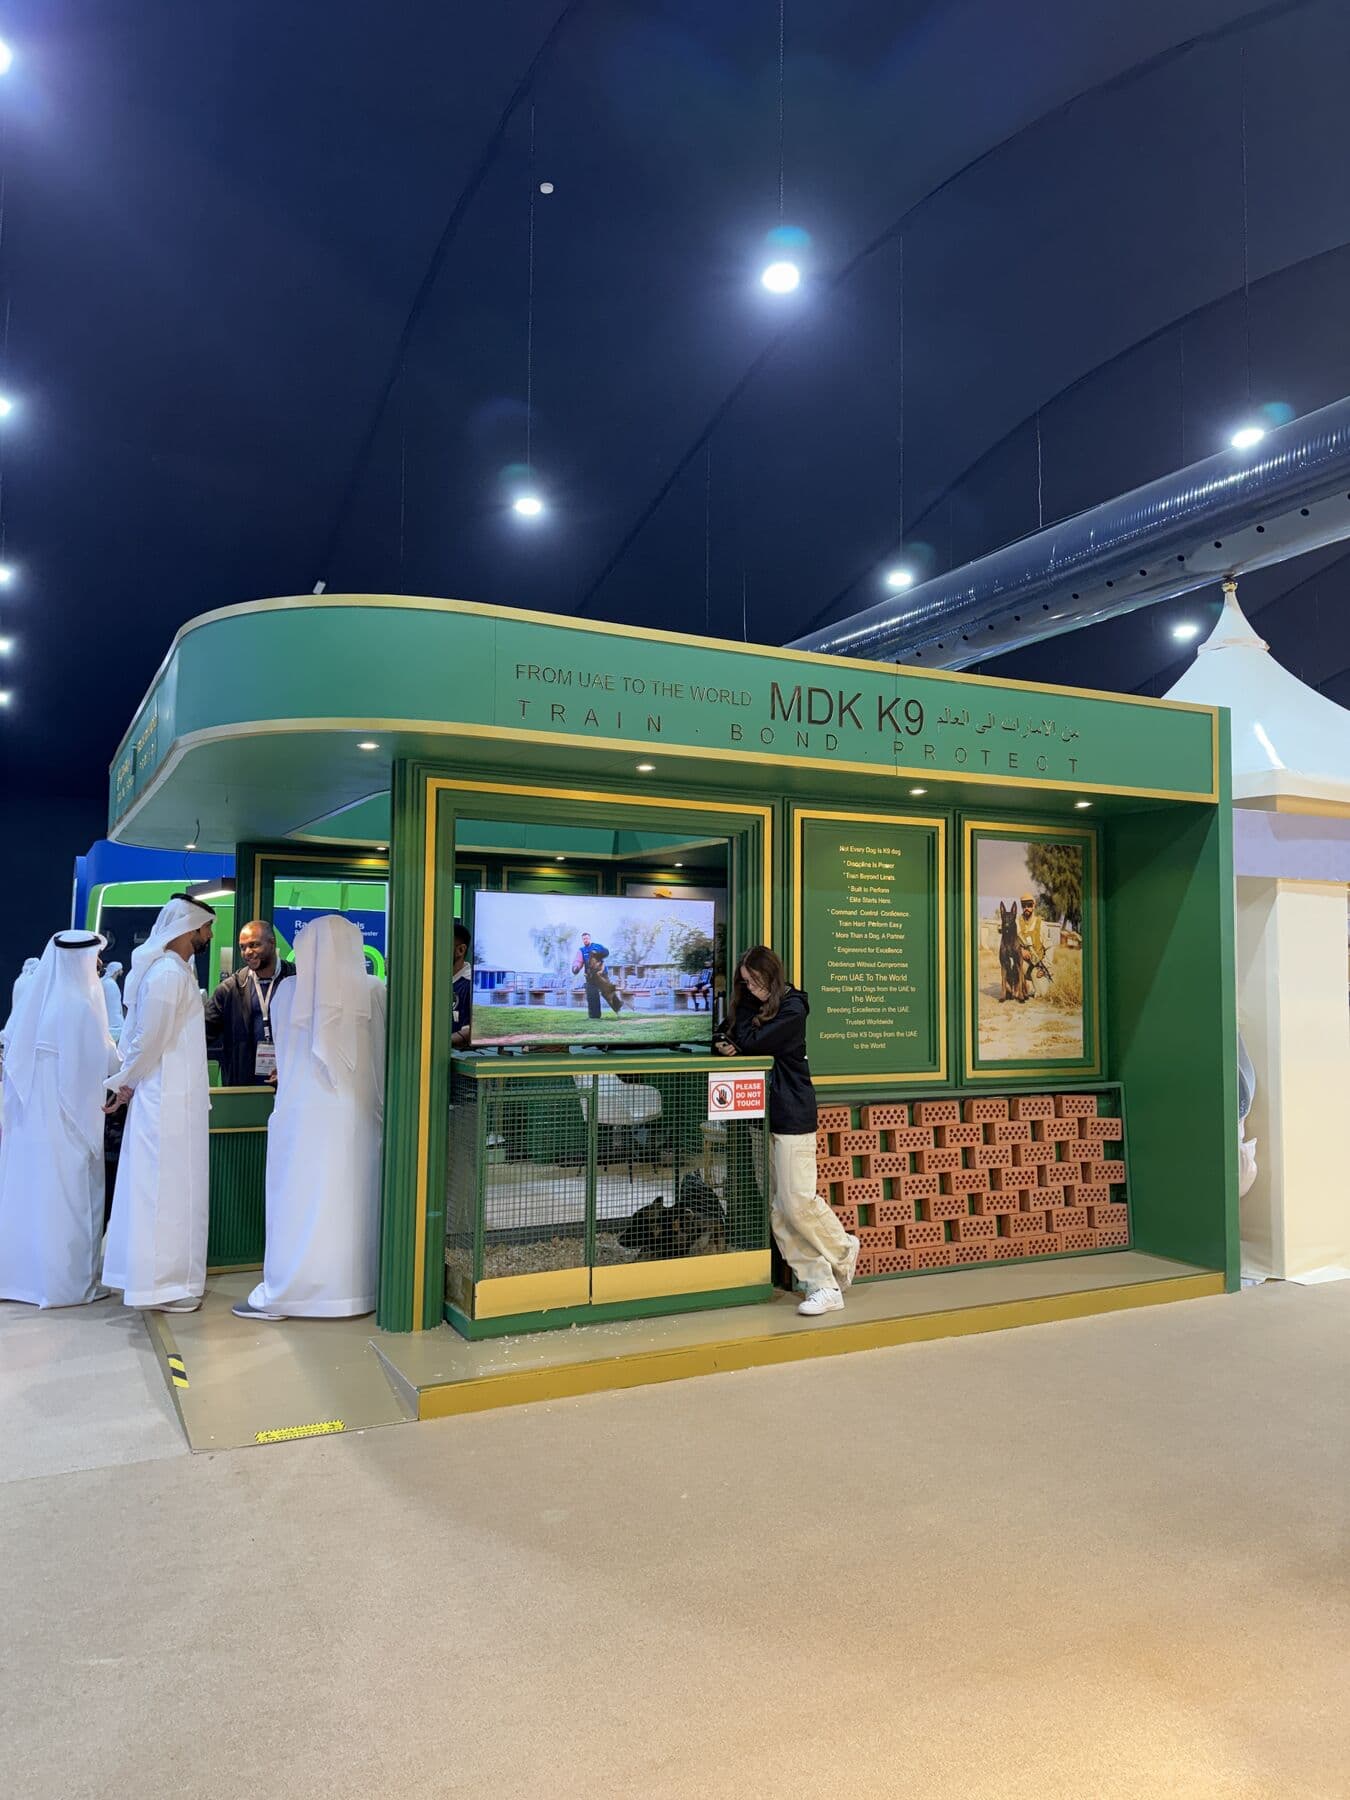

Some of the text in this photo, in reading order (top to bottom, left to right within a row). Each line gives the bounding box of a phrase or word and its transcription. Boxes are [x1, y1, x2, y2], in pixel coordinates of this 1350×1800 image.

[515, 664, 752, 706] FROM UAE TO THE WORLD
[770, 682, 924, 736] MDK K9
[518, 700, 1078, 774] TRAIN BOND PROTECT
[850, 846, 865, 854] Every
[827, 1006, 851, 1014] Breeding
